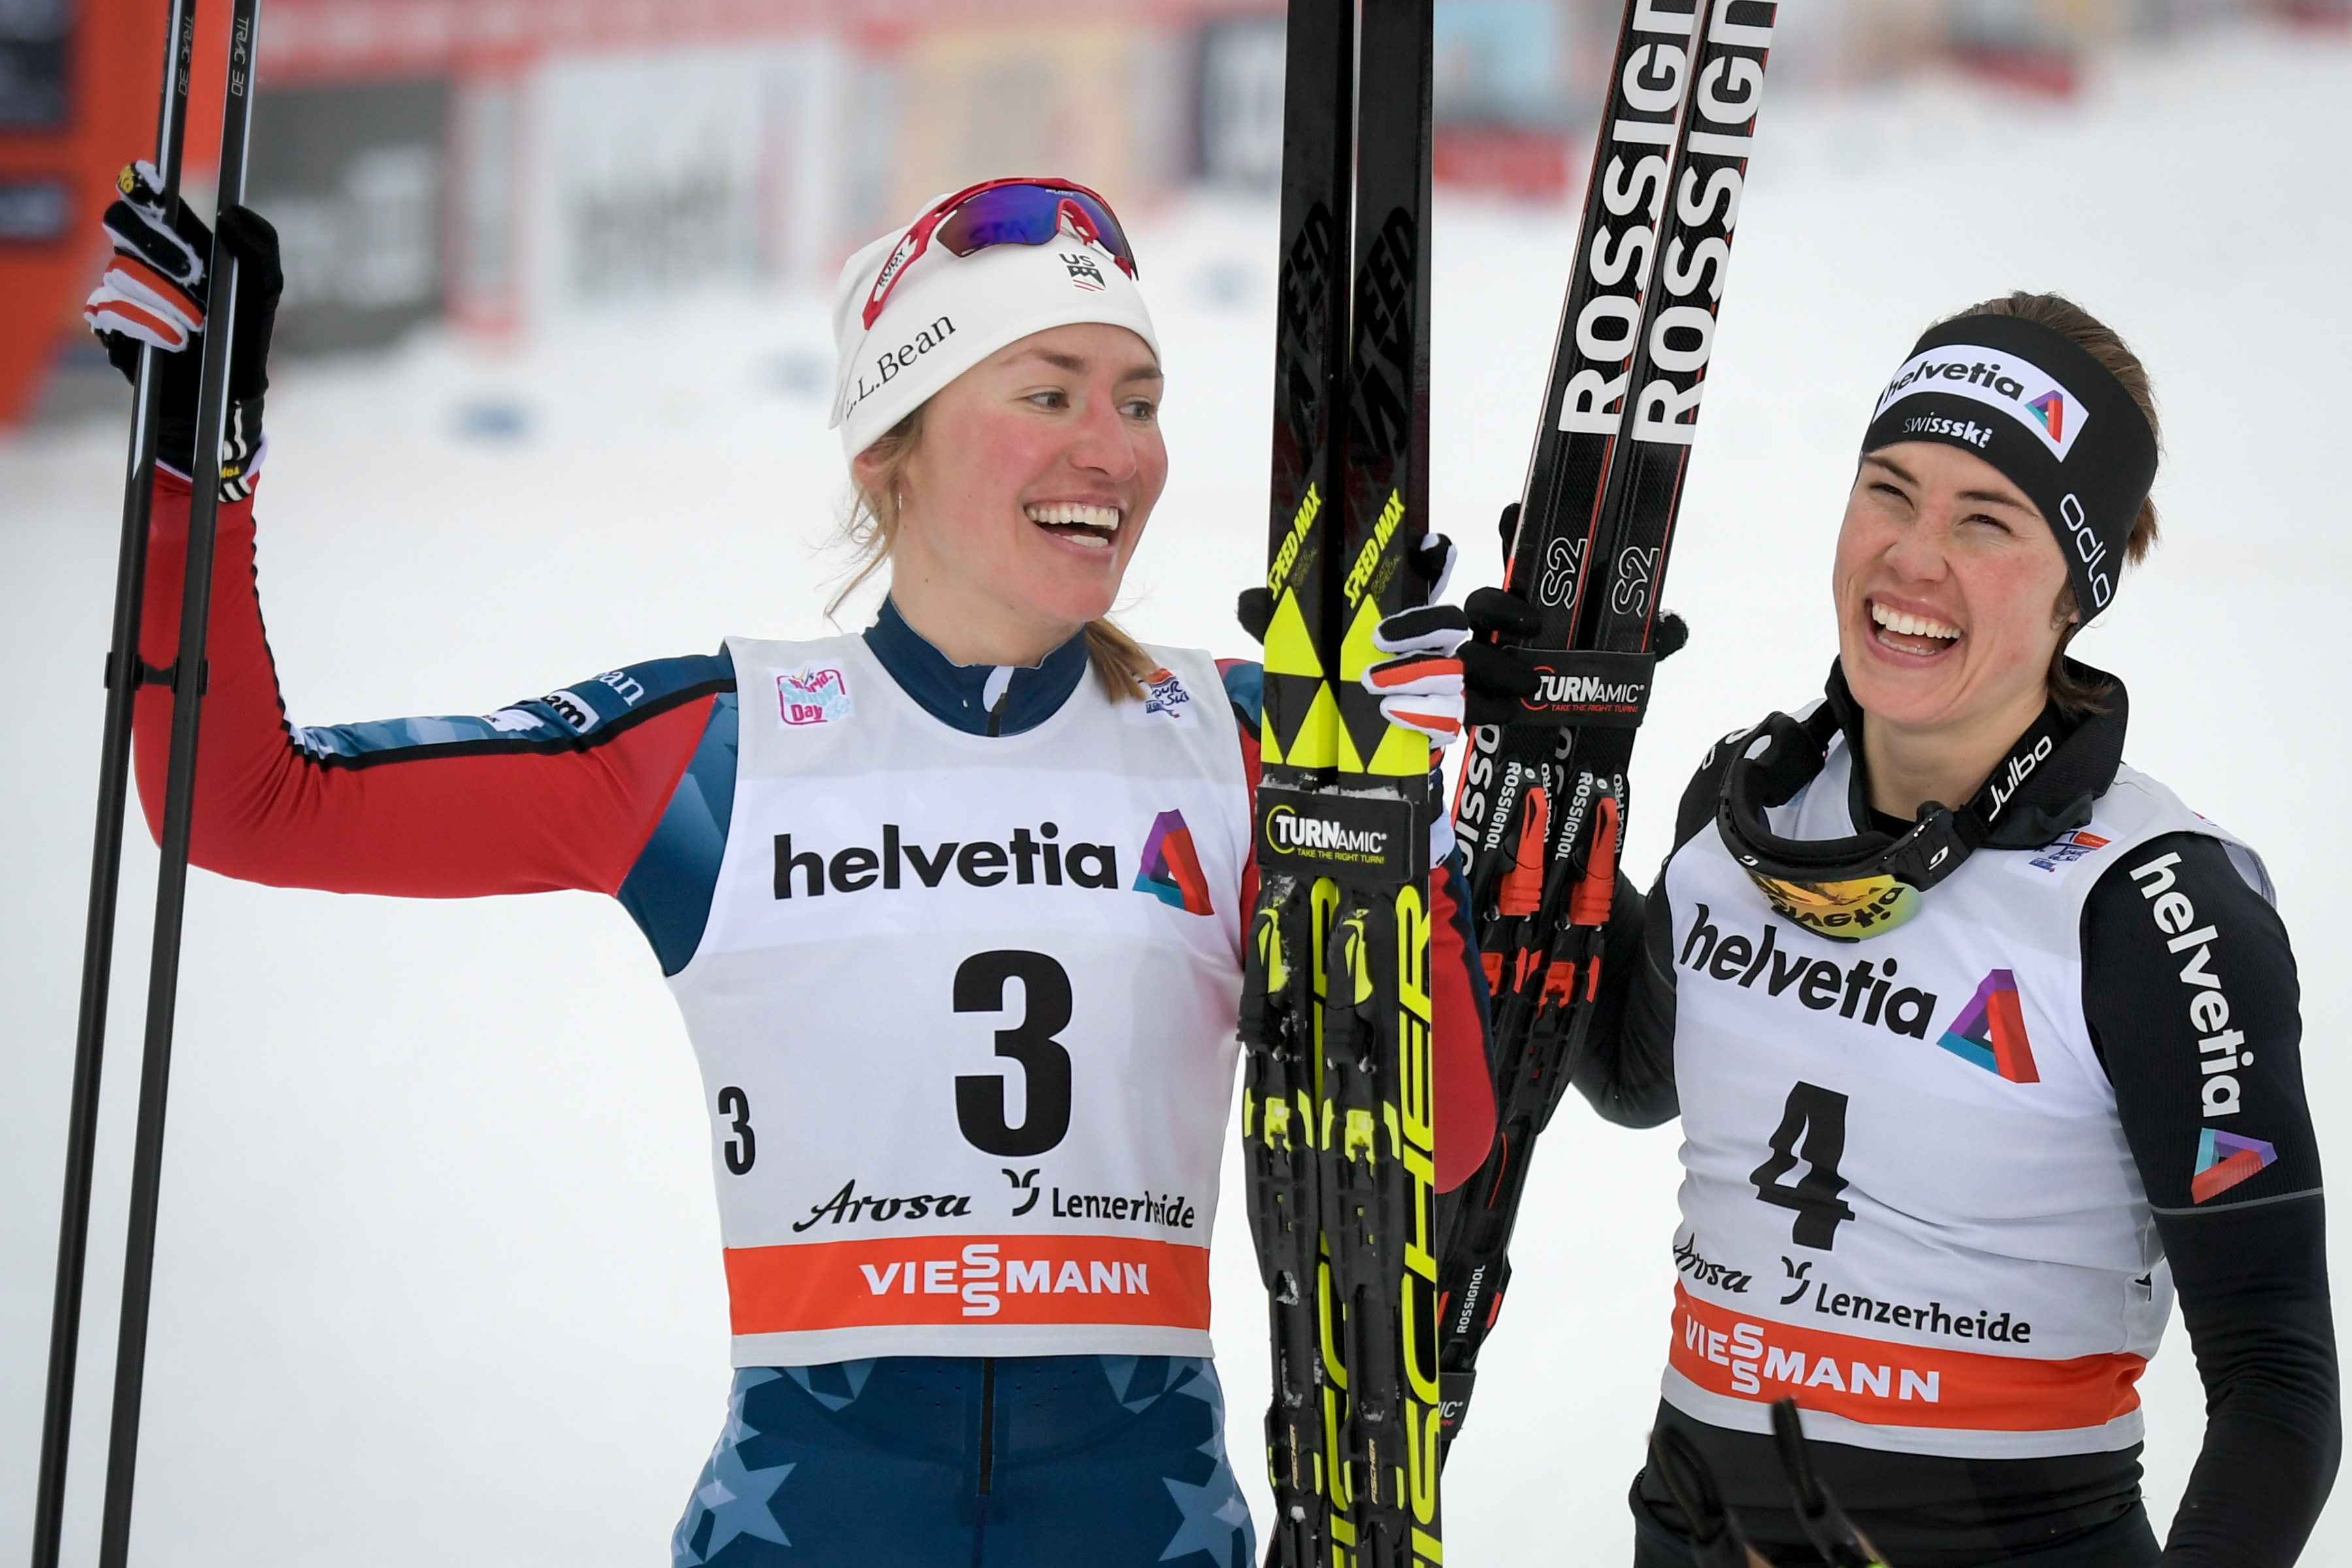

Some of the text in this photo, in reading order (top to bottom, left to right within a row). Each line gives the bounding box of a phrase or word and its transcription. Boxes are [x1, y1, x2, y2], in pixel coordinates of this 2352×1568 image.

[1058, 253, 1096, 267] US
[1884, 360, 2025, 405] helvetia
[1903, 411, 1993, 449] swissski
[1294, 481, 1322, 544] MAX
[1343, 538, 1380, 610] SPEED
[1373, 487, 1405, 552] MAX
[2059, 493, 2111, 608] odlo
[1540, 536, 1589, 610] S2
[1611, 546, 1661, 618] S2
[791, 704, 823, 721] Day
[1484, 761, 1522, 852] ROSSIGNOL
[1555, 771, 1594, 862] ROSSIGNOL
[1988, 735, 2053, 823] Julbo
[774, 822, 1119, 900] helvetia
[1297, 849, 1316, 859] TAKE
[1318, 851, 1333, 860] THE
[1334, 852, 1358, 862] RIGHT
[1679, 902, 1937, 1040] helvetia
[2129, 851, 2255, 1117] helvetia
[953, 949, 1073, 1157] 3
[717, 1086, 756, 1175] 3
[1749, 1081, 1855, 1251] 4
[792, 1179, 1195, 1233] Arosa Lenzerheide
[859, 1243, 1151, 1317] VIESSMANN
[1456, 1265, 1486, 1334] ROSSIGNOL
[1816, 1282, 2031, 1344] Lenzerheide
[1684, 1314, 1940, 1404] VIESSMANN
